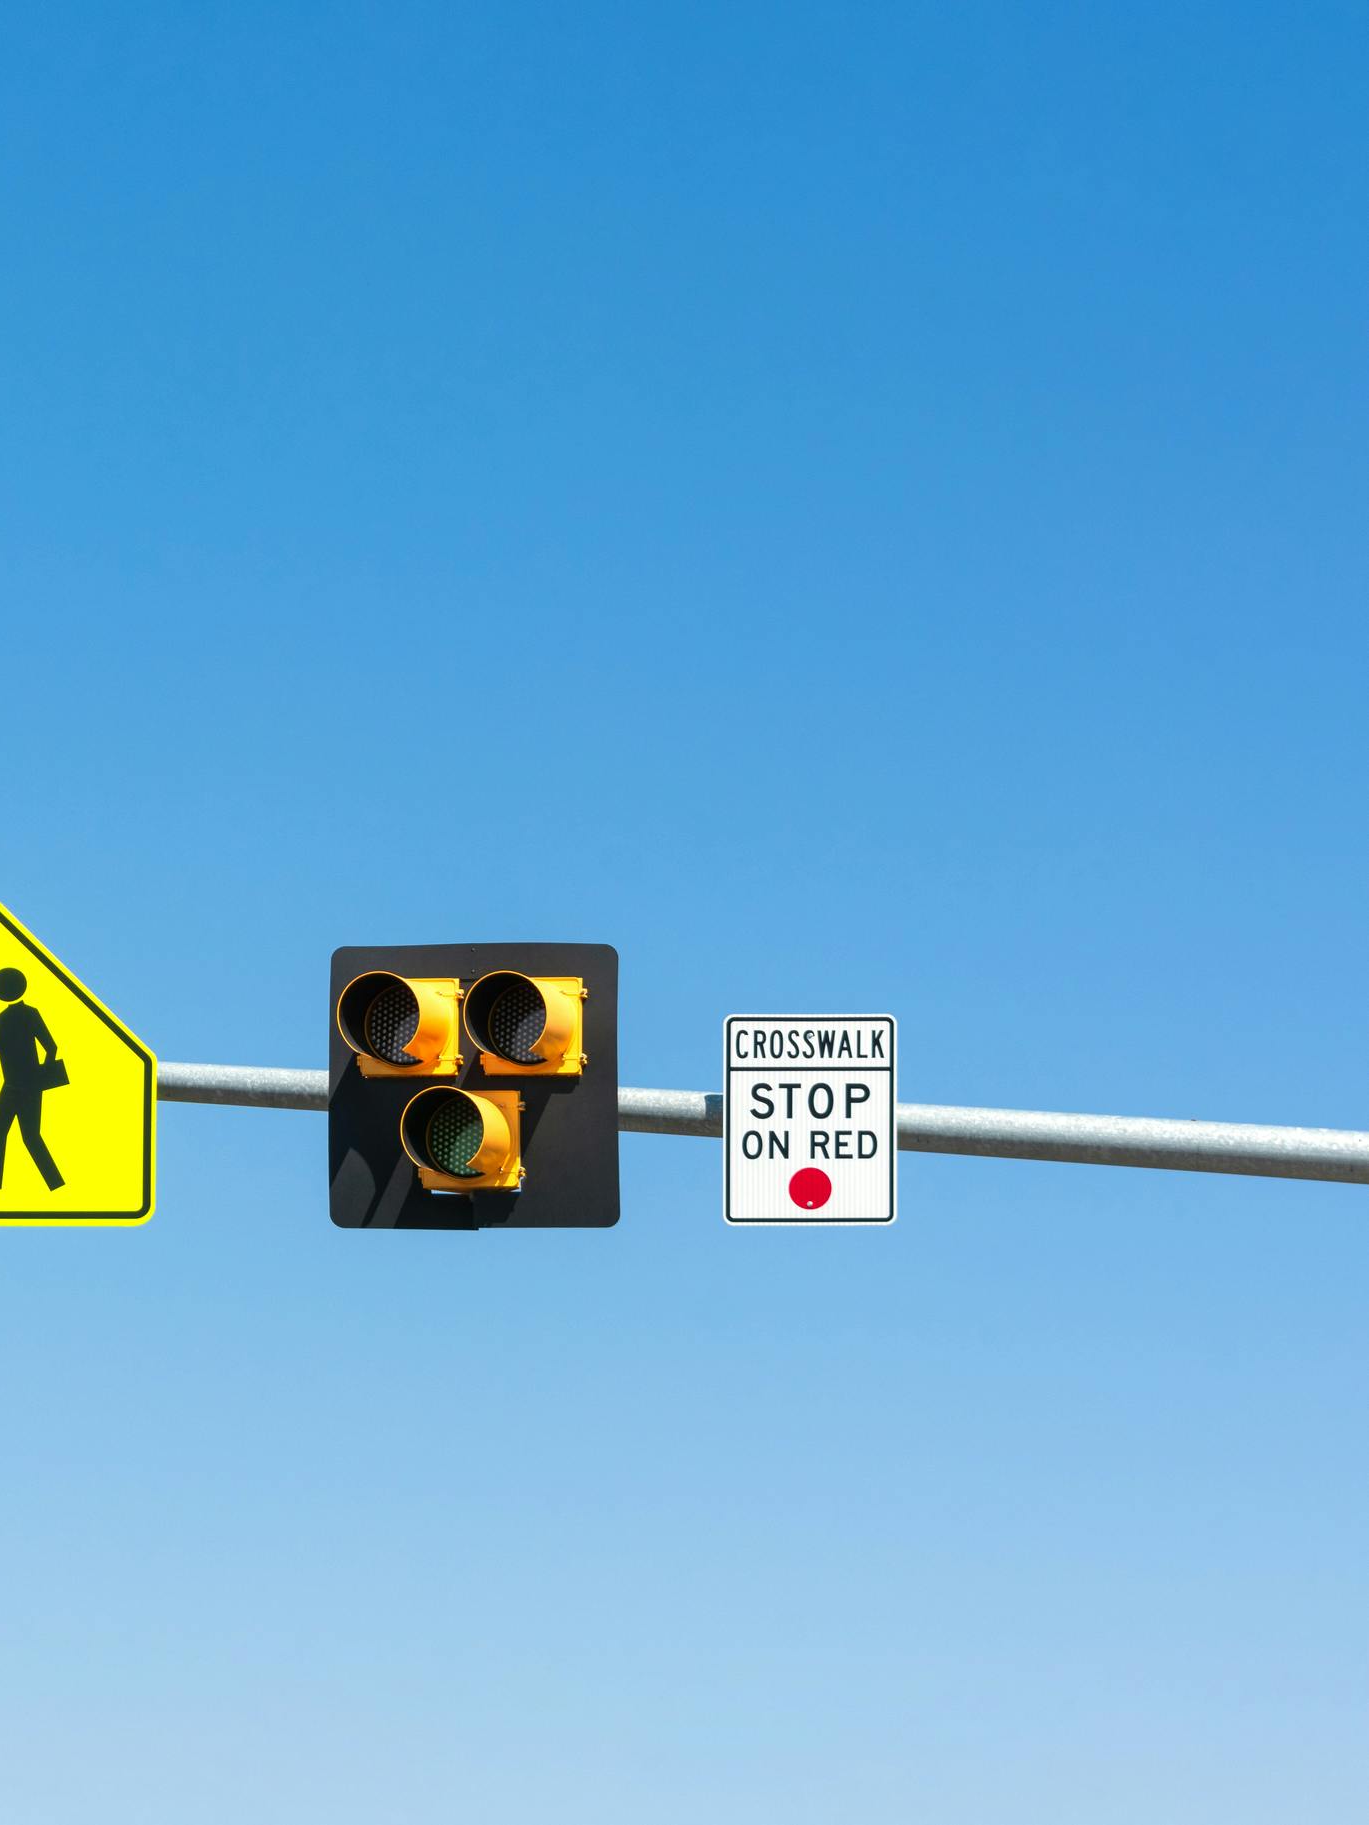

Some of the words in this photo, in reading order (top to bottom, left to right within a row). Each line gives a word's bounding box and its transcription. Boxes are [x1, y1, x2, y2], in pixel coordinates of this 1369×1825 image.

[735, 1029, 885, 1059] CROSSWALK
[750, 1082, 871, 1120] STOP
[742, 1130, 789, 1160] ON
[810, 1130, 878, 1159] RED
